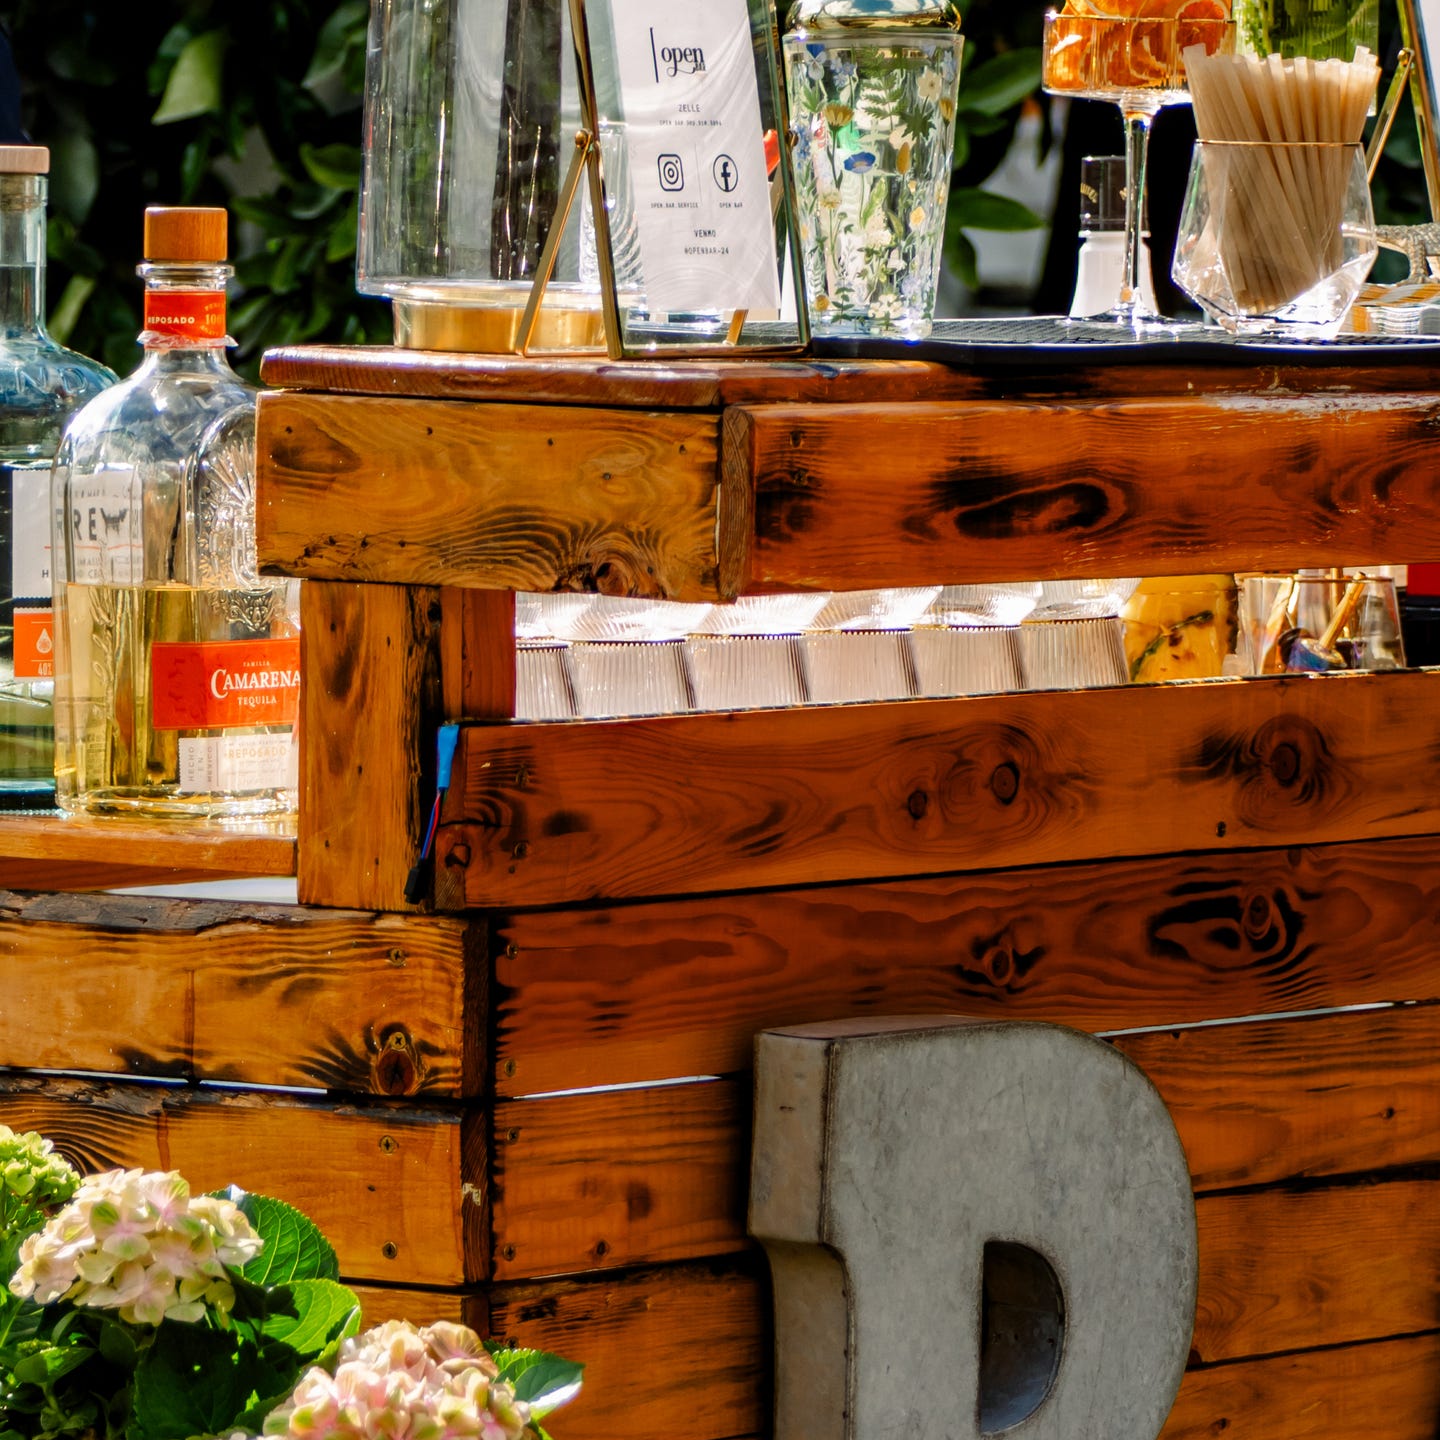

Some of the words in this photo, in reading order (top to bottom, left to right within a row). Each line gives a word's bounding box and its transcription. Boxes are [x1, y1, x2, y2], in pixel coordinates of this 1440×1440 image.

[661, 47, 704, 77] open
[678, 104, 701, 113] ZELLE
[694, 229, 717, 238] VENMO
[211, 669, 300, 699] CAMARENA
[238, 695, 277, 707] TEQUILA
[229, 746, 287, 759] REPOSADO
